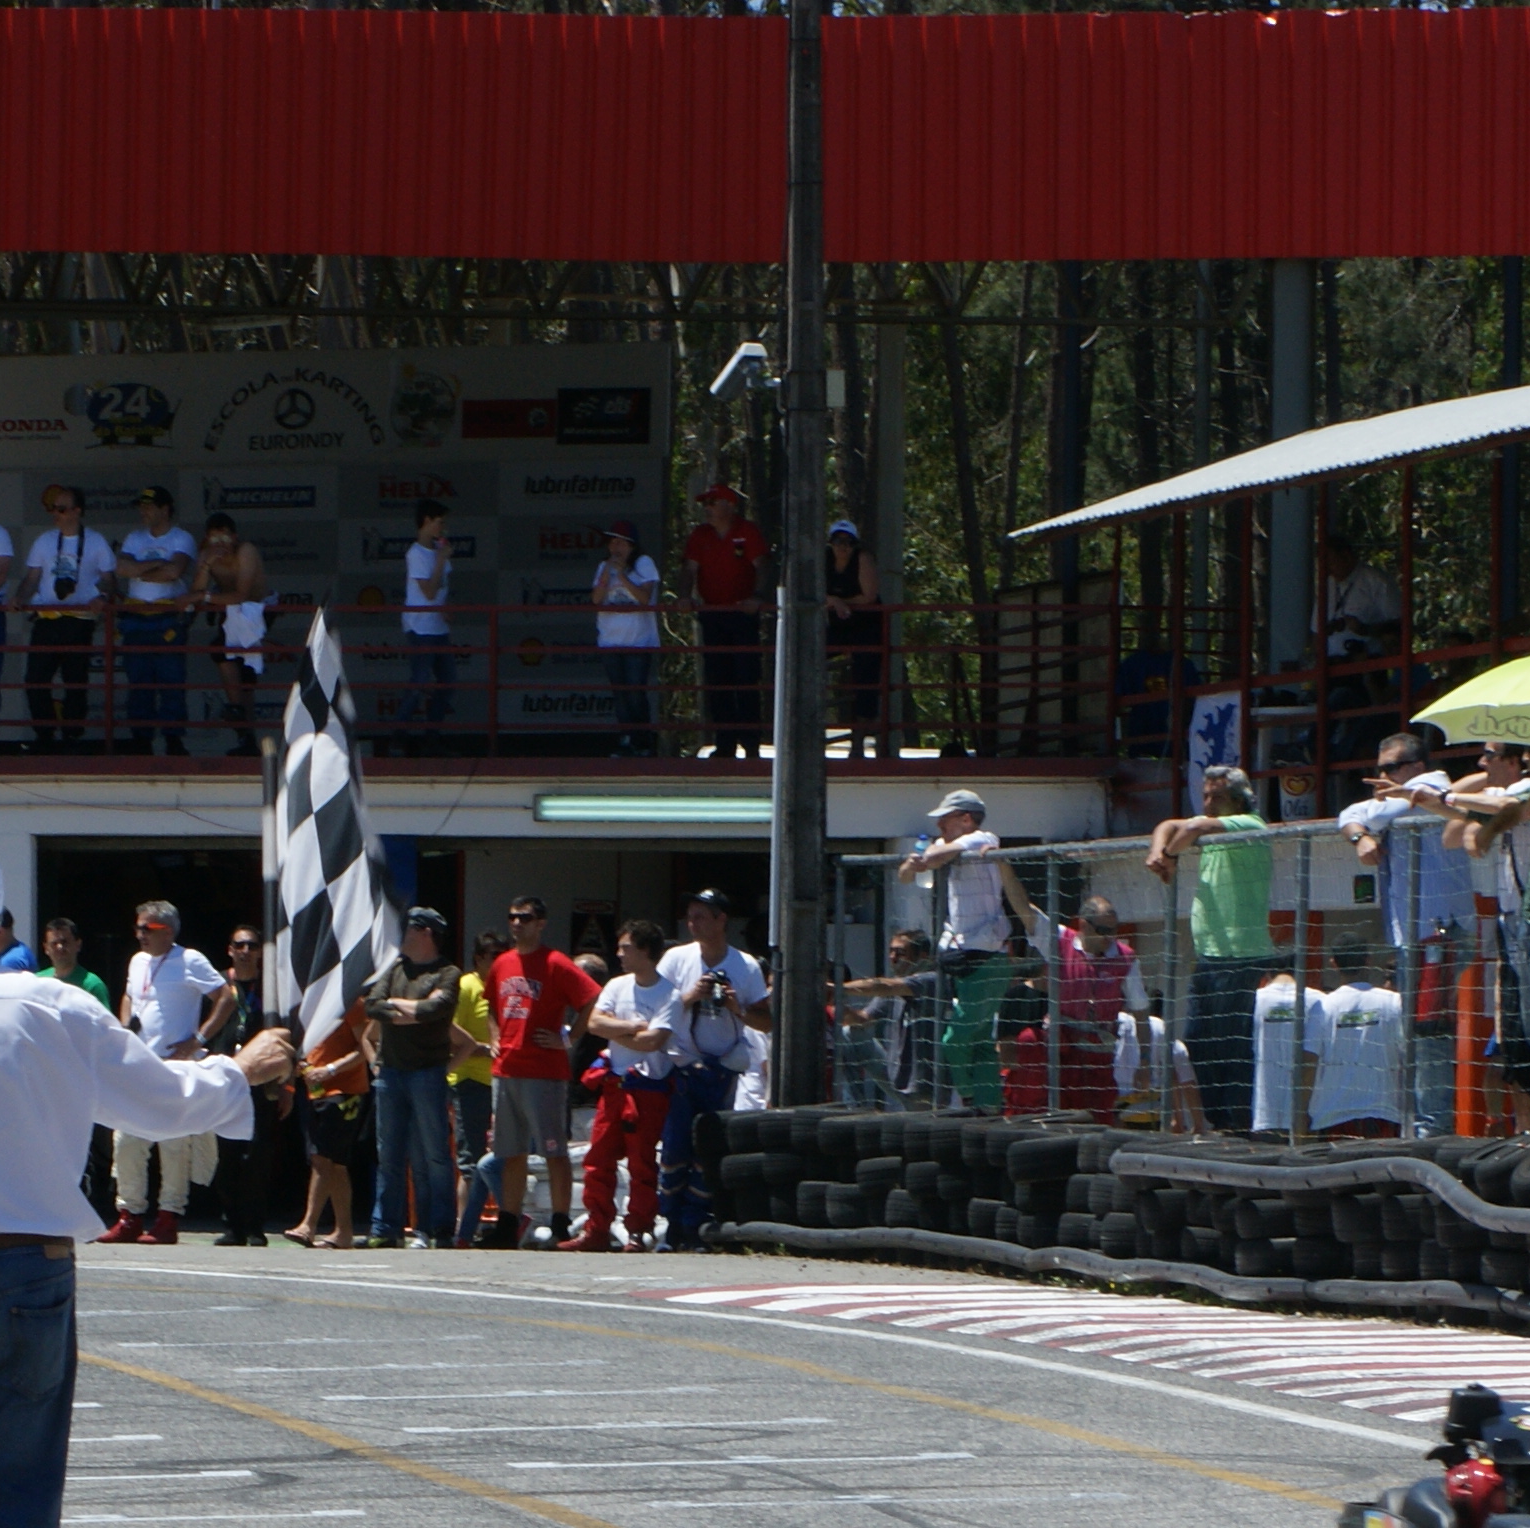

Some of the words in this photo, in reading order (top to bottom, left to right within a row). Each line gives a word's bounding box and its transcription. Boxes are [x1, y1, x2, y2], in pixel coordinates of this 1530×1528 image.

[98, 386, 151, 419] 24
[205, 372, 279, 451] ESCOLA
[295, 368, 385, 445] KARTING
[248, 432, 344, 451] EUROINDY
[378, 479, 454, 498] HELIX
